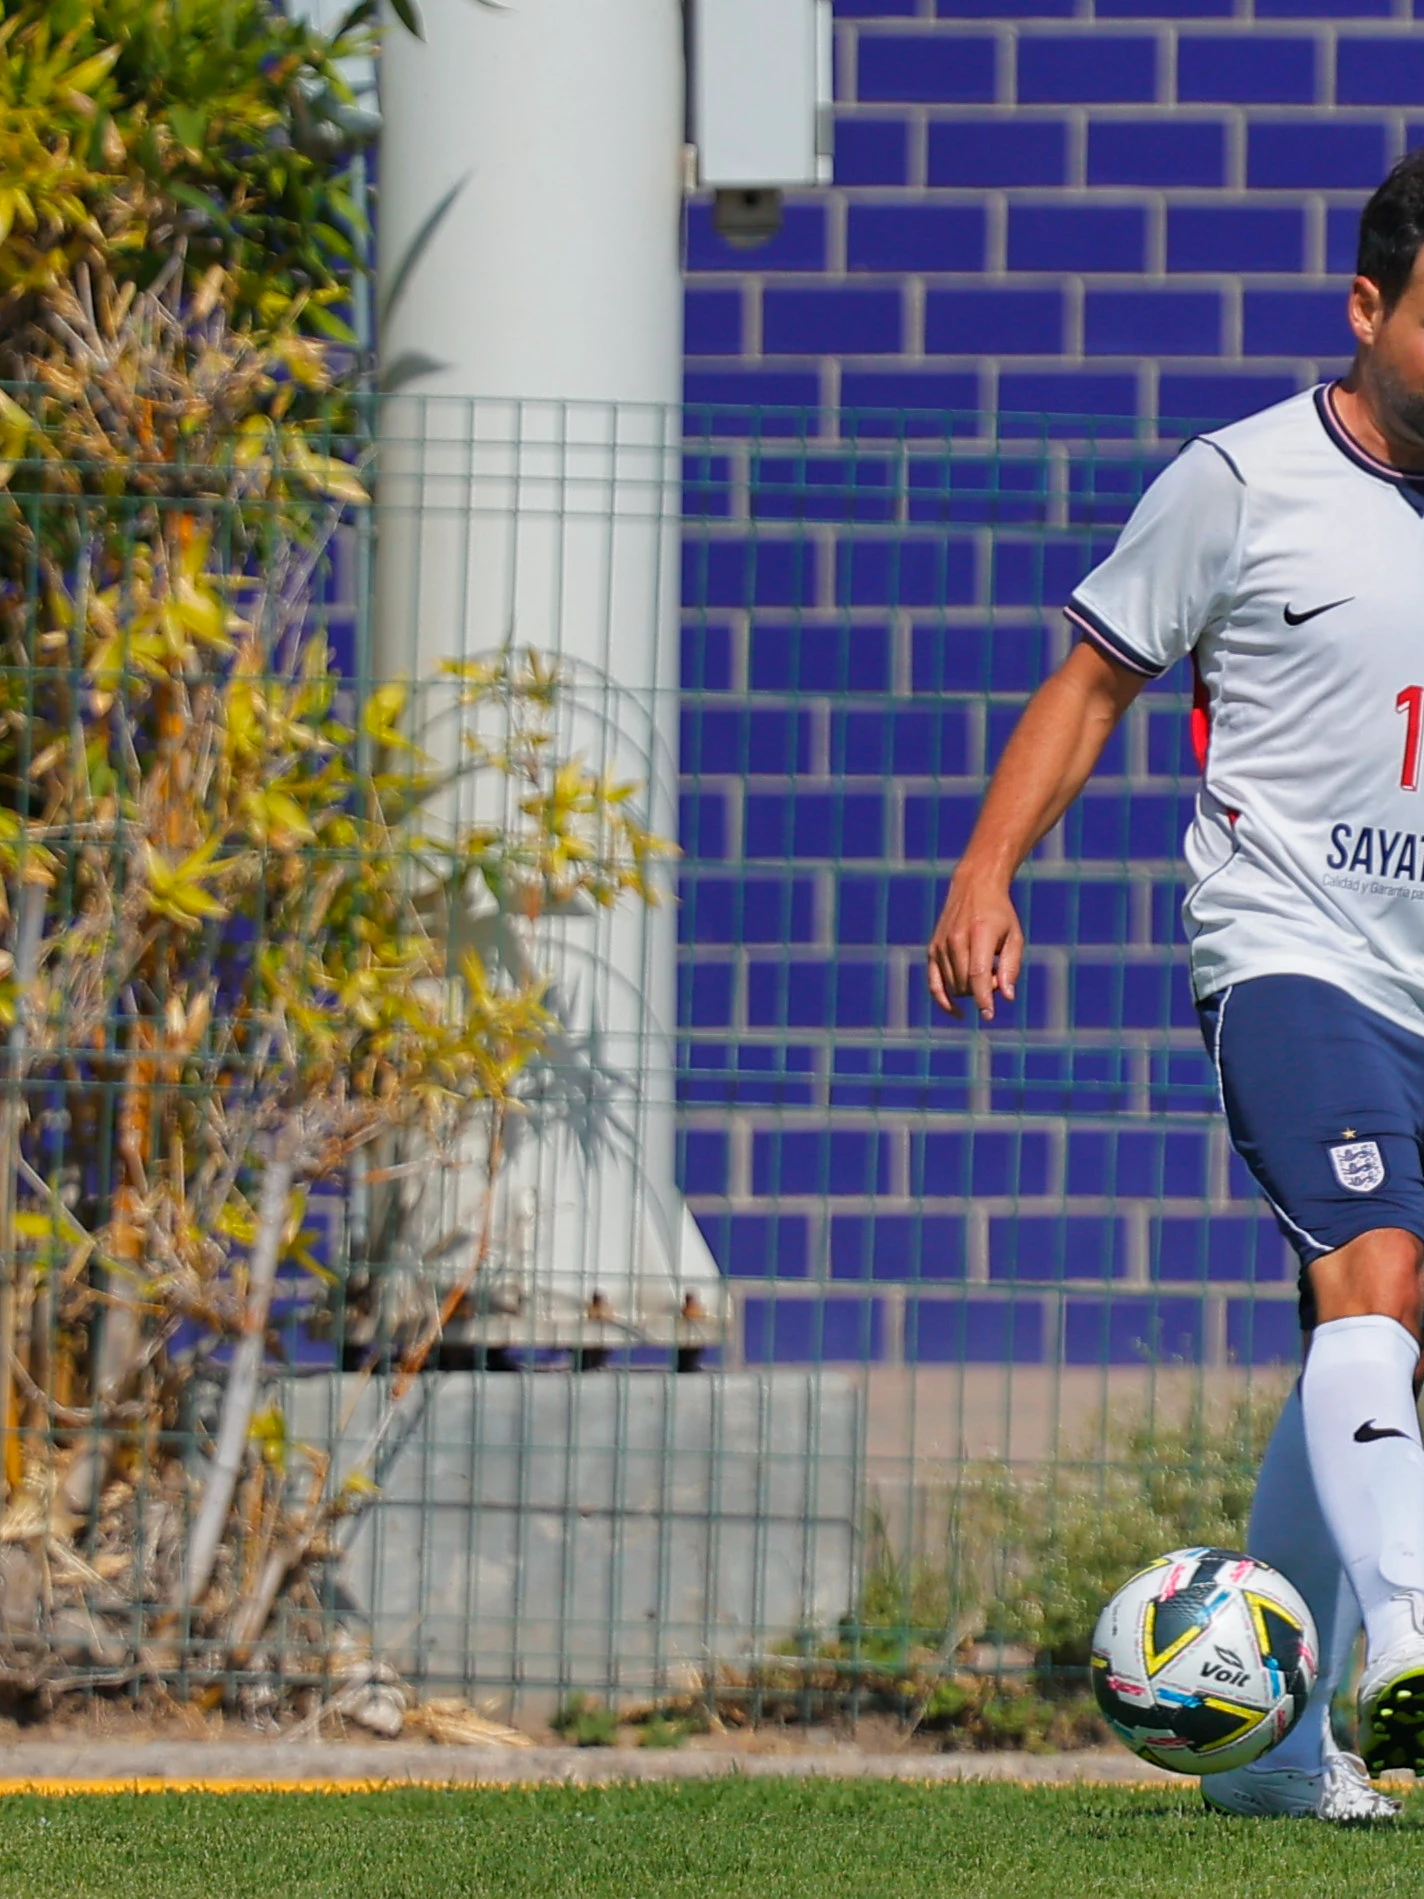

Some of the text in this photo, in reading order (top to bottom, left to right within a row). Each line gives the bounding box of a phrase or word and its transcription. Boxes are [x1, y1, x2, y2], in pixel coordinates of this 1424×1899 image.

[1322, 873, 1359, 891] Calidad
[1361, 883, 1369, 894] y
[1200, 1661, 1251, 1687] Voit
